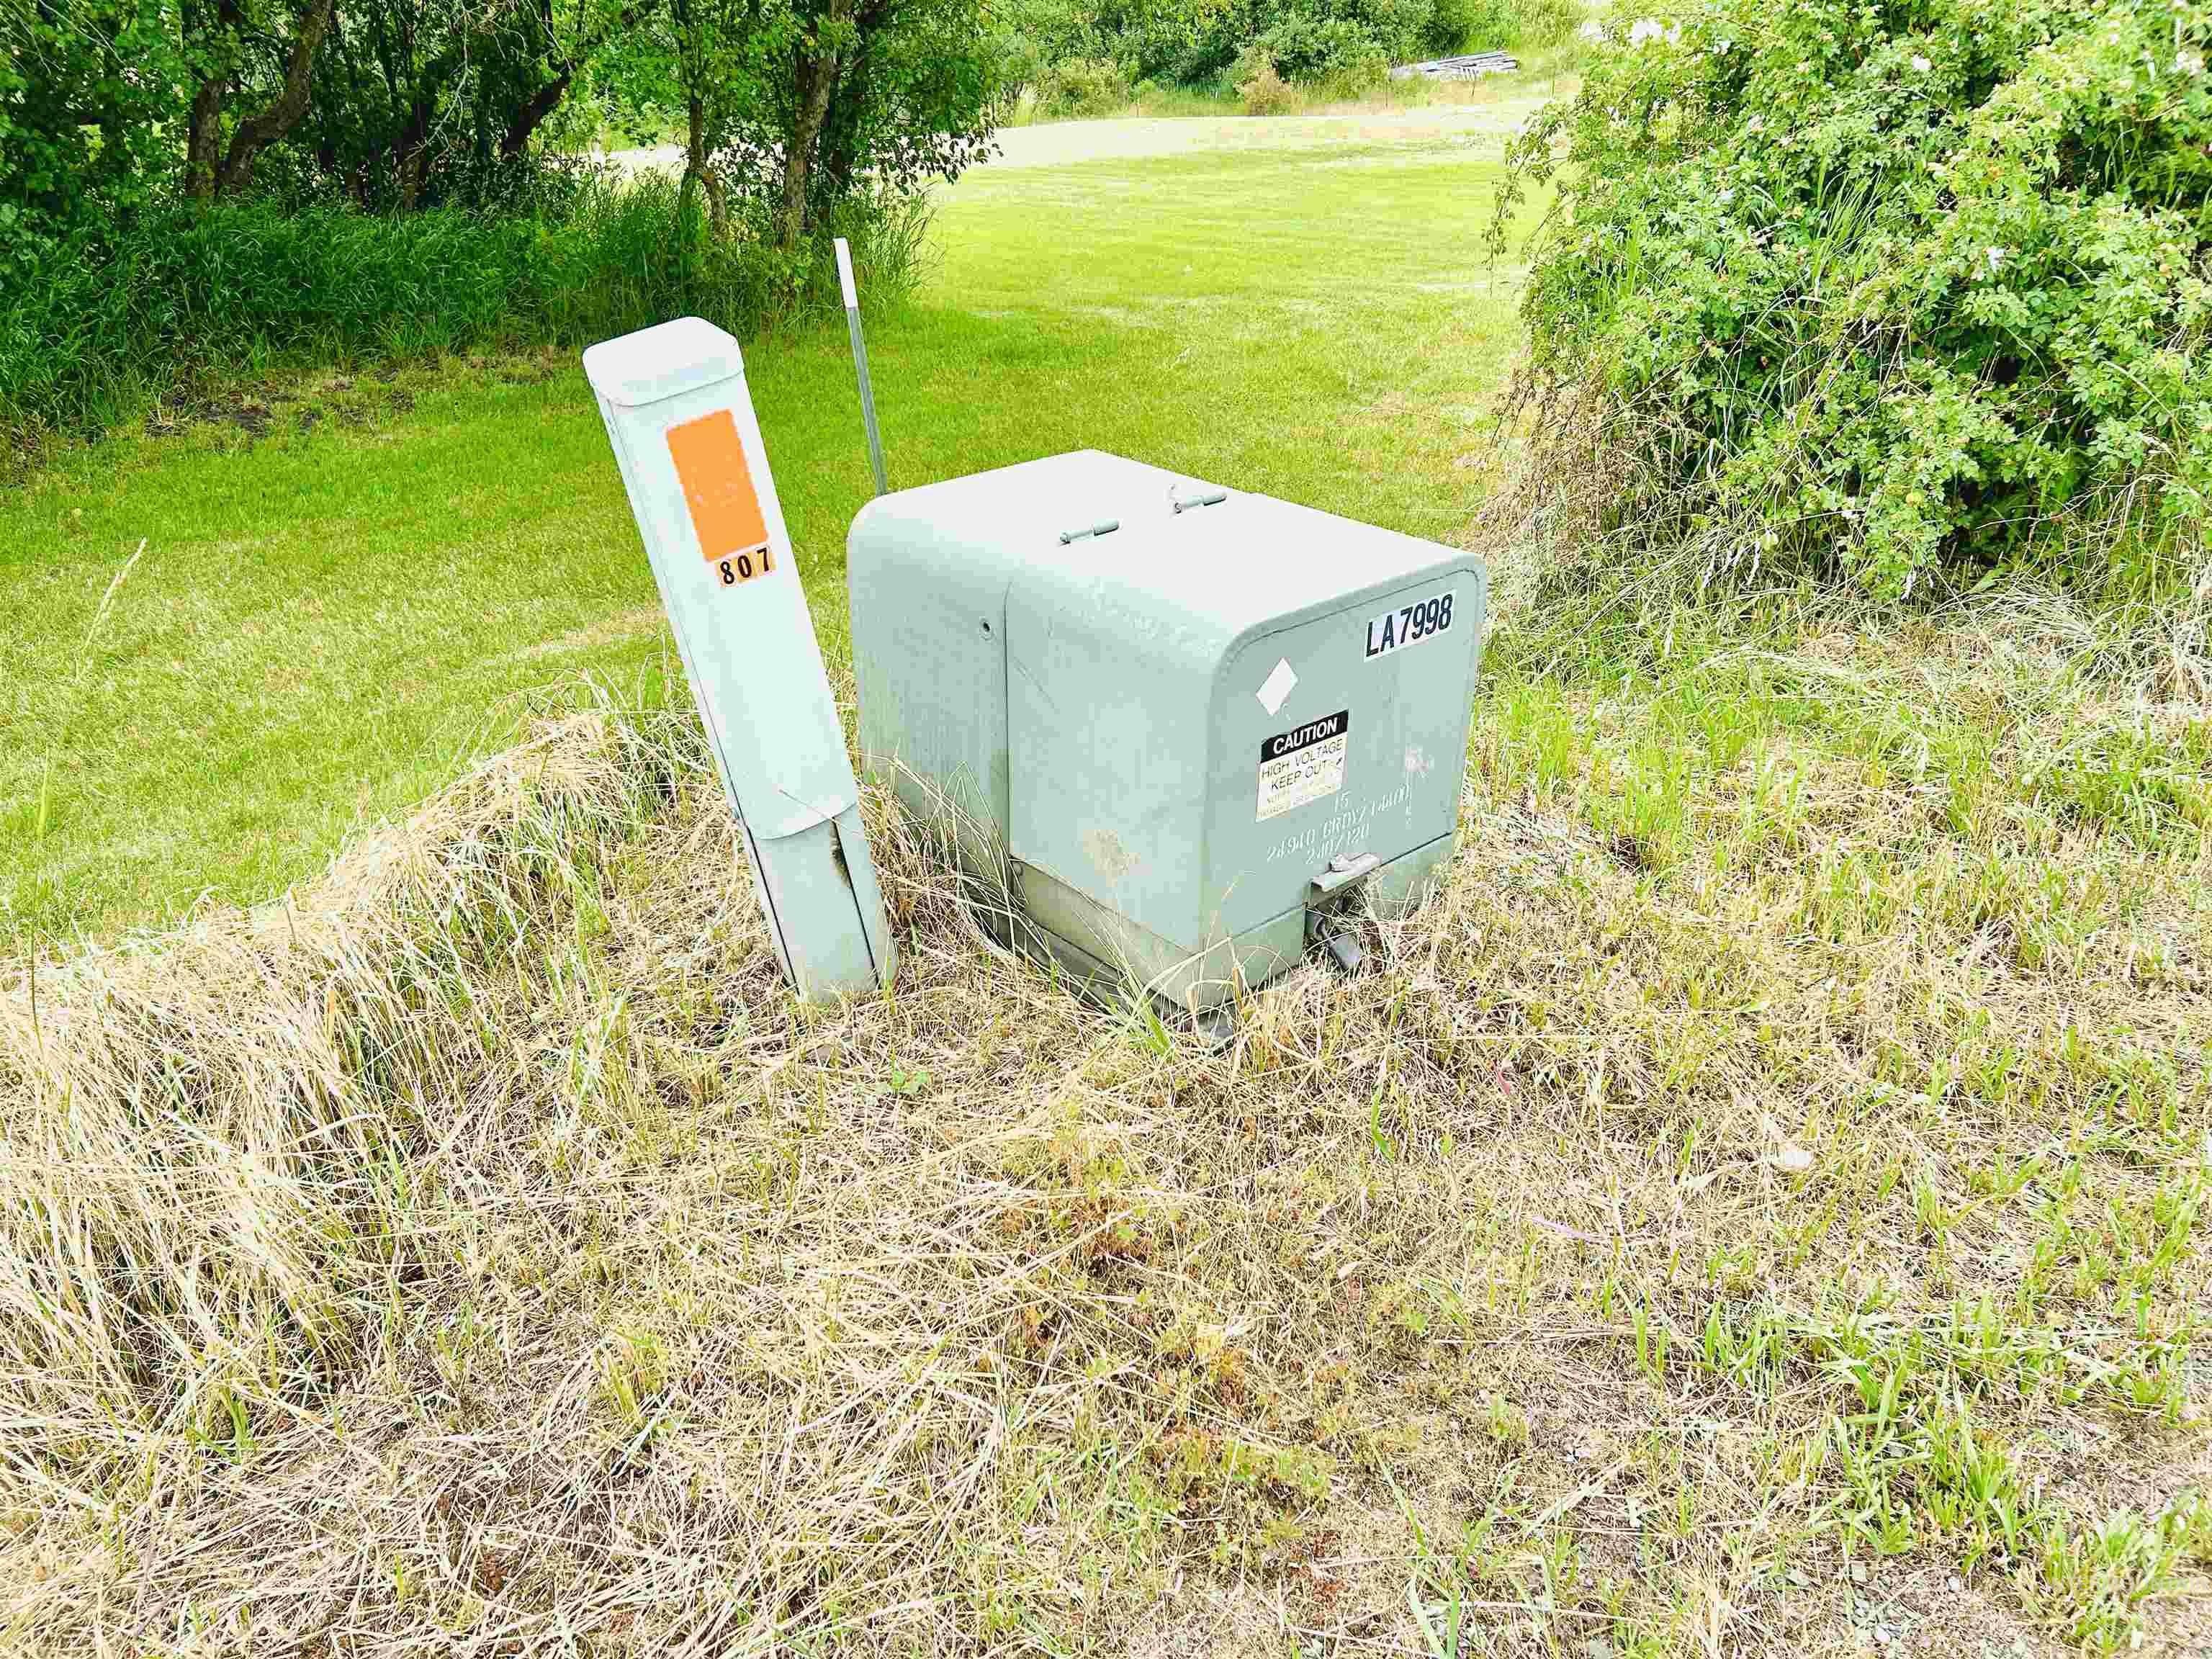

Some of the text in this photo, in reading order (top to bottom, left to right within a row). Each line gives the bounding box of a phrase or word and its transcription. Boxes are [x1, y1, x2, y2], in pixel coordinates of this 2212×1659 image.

[719, 547, 770, 585] 807
[1272, 717, 1338, 755] CAUTION
[1262, 738, 1343, 779] HIGH VOLTAGE
[1272, 770, 1301, 791] KEEP
